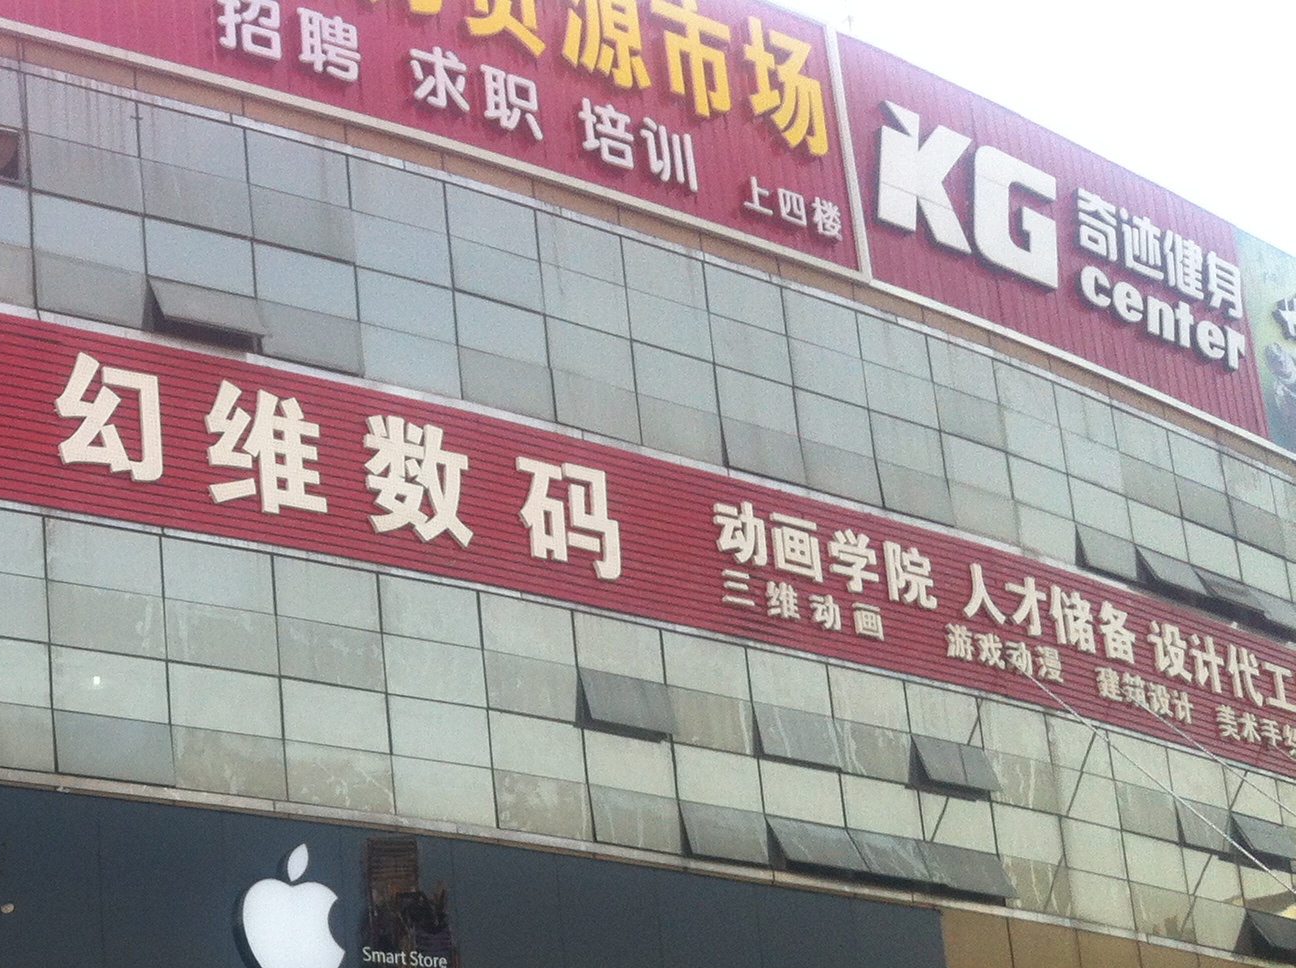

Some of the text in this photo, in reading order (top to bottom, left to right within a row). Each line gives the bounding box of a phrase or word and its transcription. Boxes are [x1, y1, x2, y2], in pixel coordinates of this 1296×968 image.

[217, 0, 698, 192] 招聘 求职 培训
[744, 176, 842, 241] 上四楼
[877, 100, 1058, 290] KG
[1077, 187, 1244, 320] 奇迹健身
[1080, 265, 1245, 371] center
[55, 351, 622, 581] 幻维数码
[713, 501, 1296, 713] 动画学院 人才储备 设计代工
[721, 568, 885, 641] 三维动画
[945, 623, 1064, 683] 游戏动漫
[1095, 667, 1193, 724] 建筑设计
[362, 946, 448, 968] Smart Store
